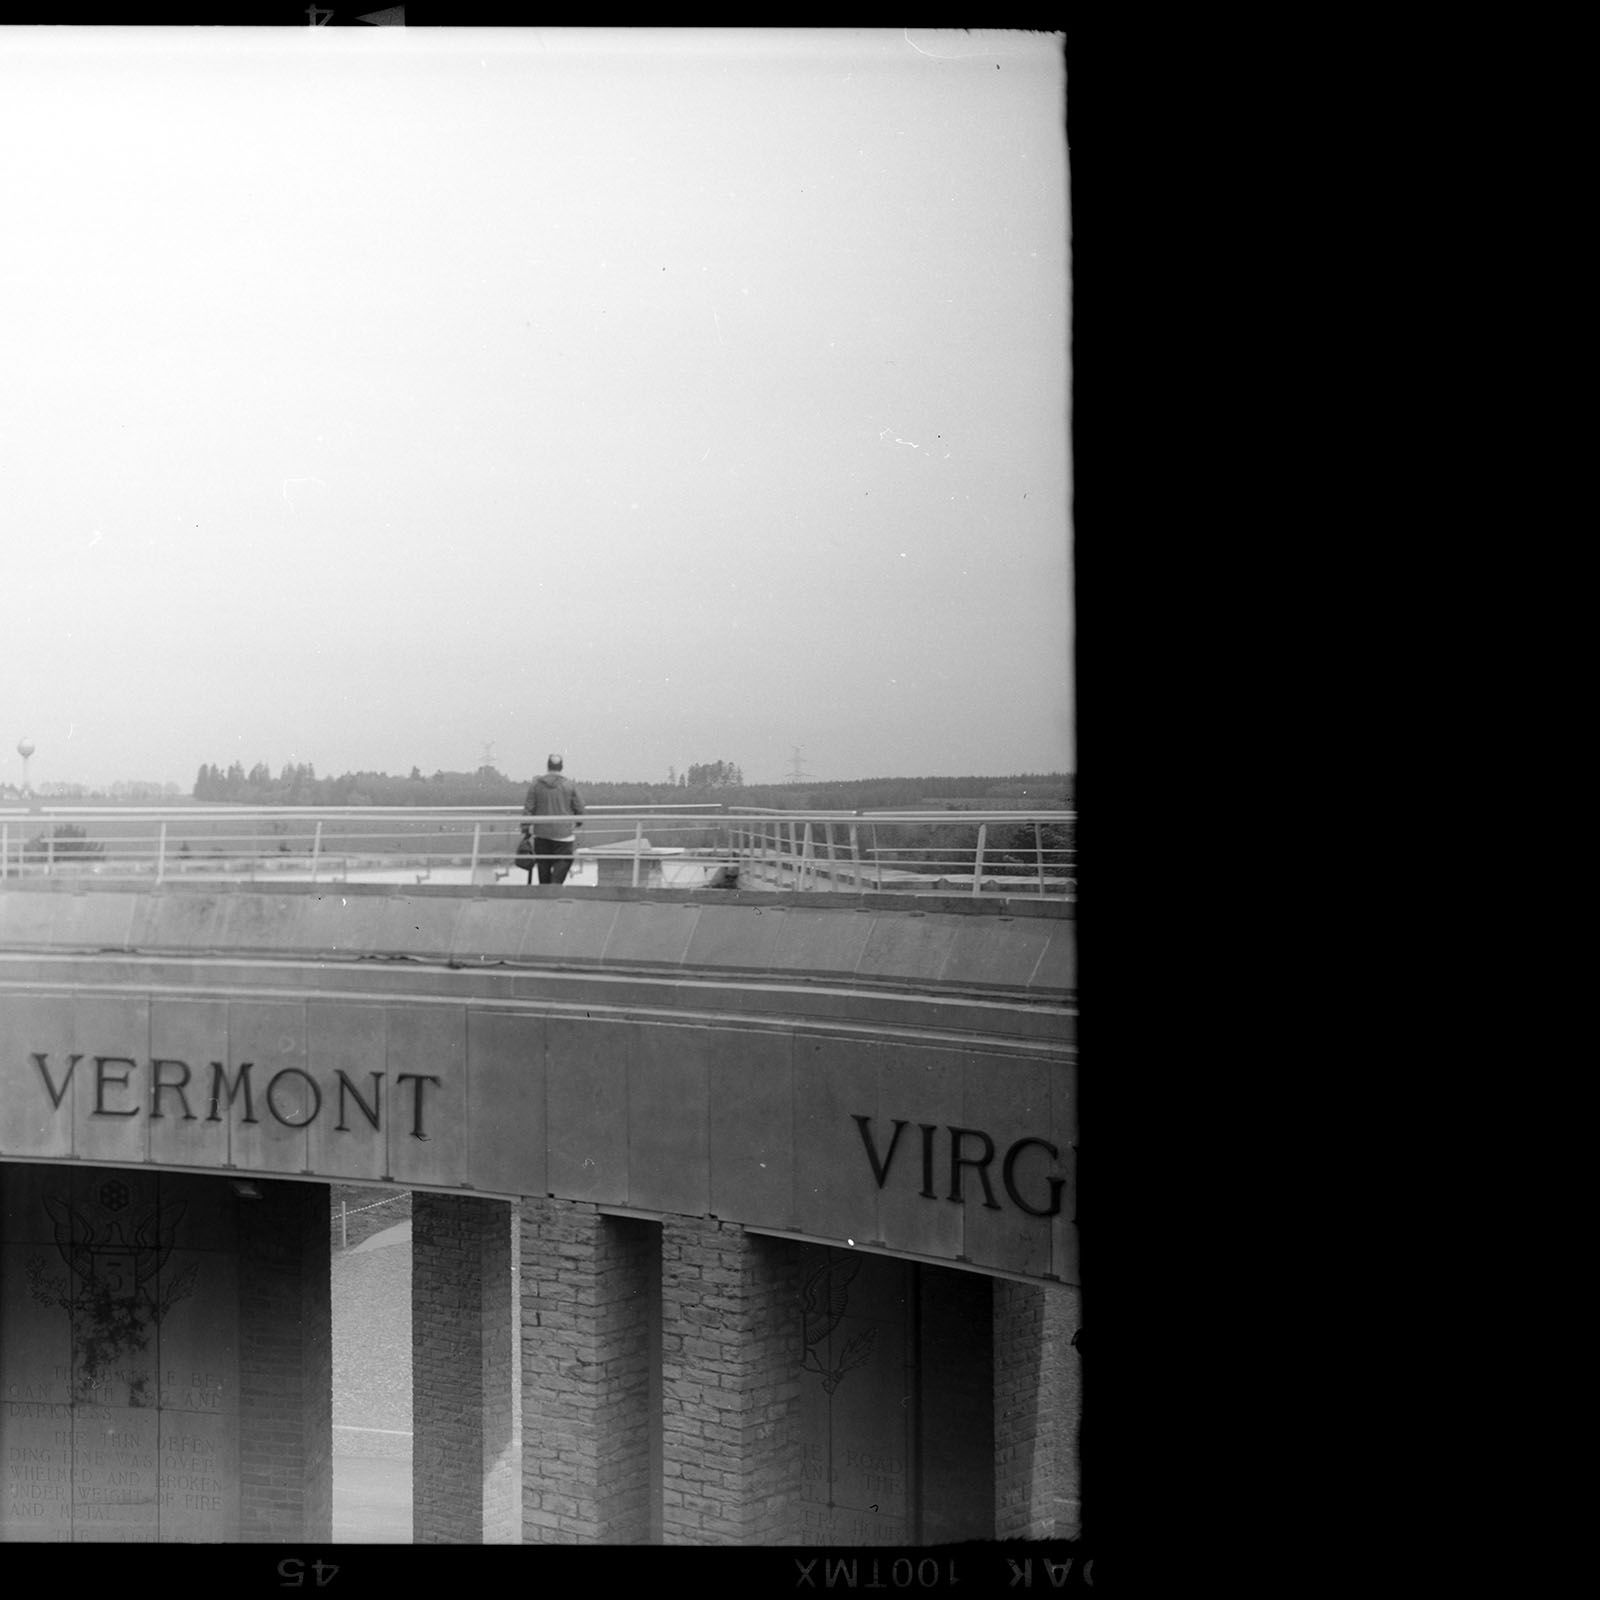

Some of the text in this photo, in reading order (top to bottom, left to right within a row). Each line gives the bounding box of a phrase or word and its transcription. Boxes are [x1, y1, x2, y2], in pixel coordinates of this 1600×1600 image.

[31, 1053, 442, 1140] VERMONT
[850, 1113, 1079, 1224] VIRG
[9, 1402, 113, 1420] DARKNESS
[99, 1432, 141, 1448] THIN
[9, 1447, 52, 1463] DING
[63, 1449, 106, 1465] LINE
[115, 1451, 154, 1469] WAS
[9, 1464, 223, 1493] WHELMED AND BROKEN
[9, 1483, 223, 1511] UNDER WEIGHT OF FIRE
[9, 1501, 45, 1518] AND
[276, 1558, 341, 1588] 45
[794, 1558, 961, 1589] 100TMX
